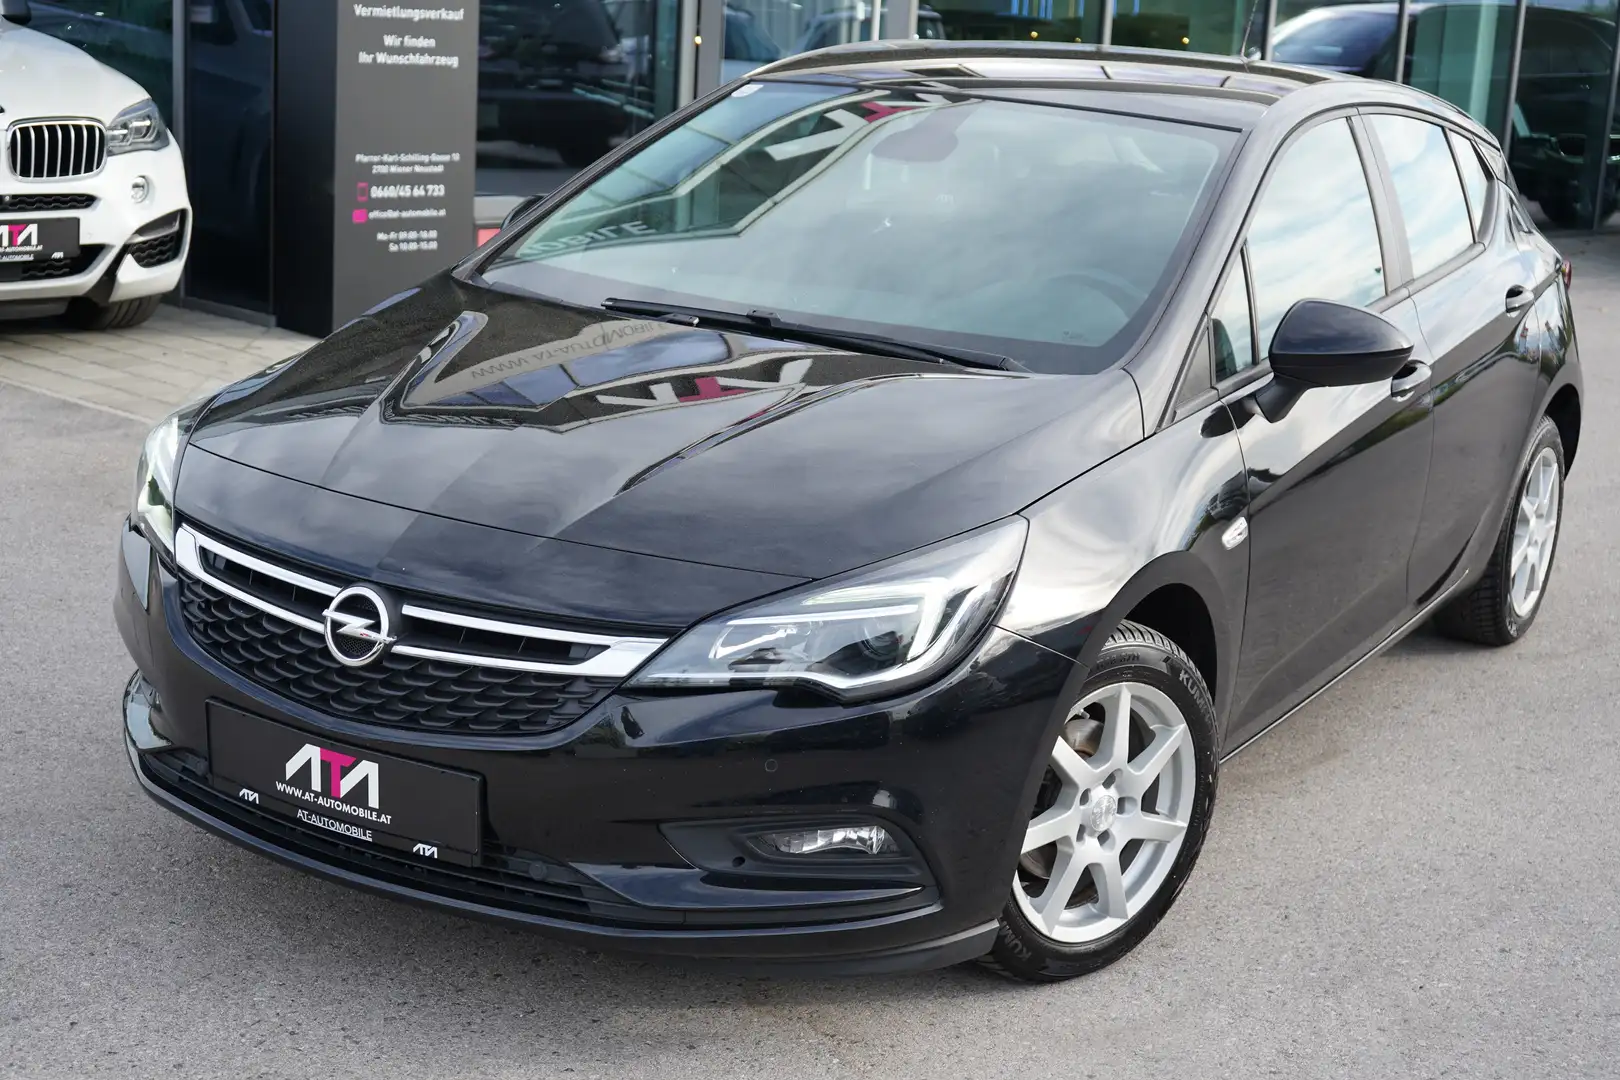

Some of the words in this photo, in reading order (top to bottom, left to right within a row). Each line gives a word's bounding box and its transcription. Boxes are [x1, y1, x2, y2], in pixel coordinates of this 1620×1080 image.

[383, 35, 402, 47] Wir
[403, 35, 436, 48] finden
[358, 52, 374, 63] Ihr
[375, 52, 459, 69] Wunschfahrzeug
[426, 184, 446, 197] 733
[286, 743, 379, 809] ATA
[275, 781, 392, 825] WWW.AT-AUTOMOBILE.AT
[297, 808, 373, 842] AT-AUTOMOBILE
